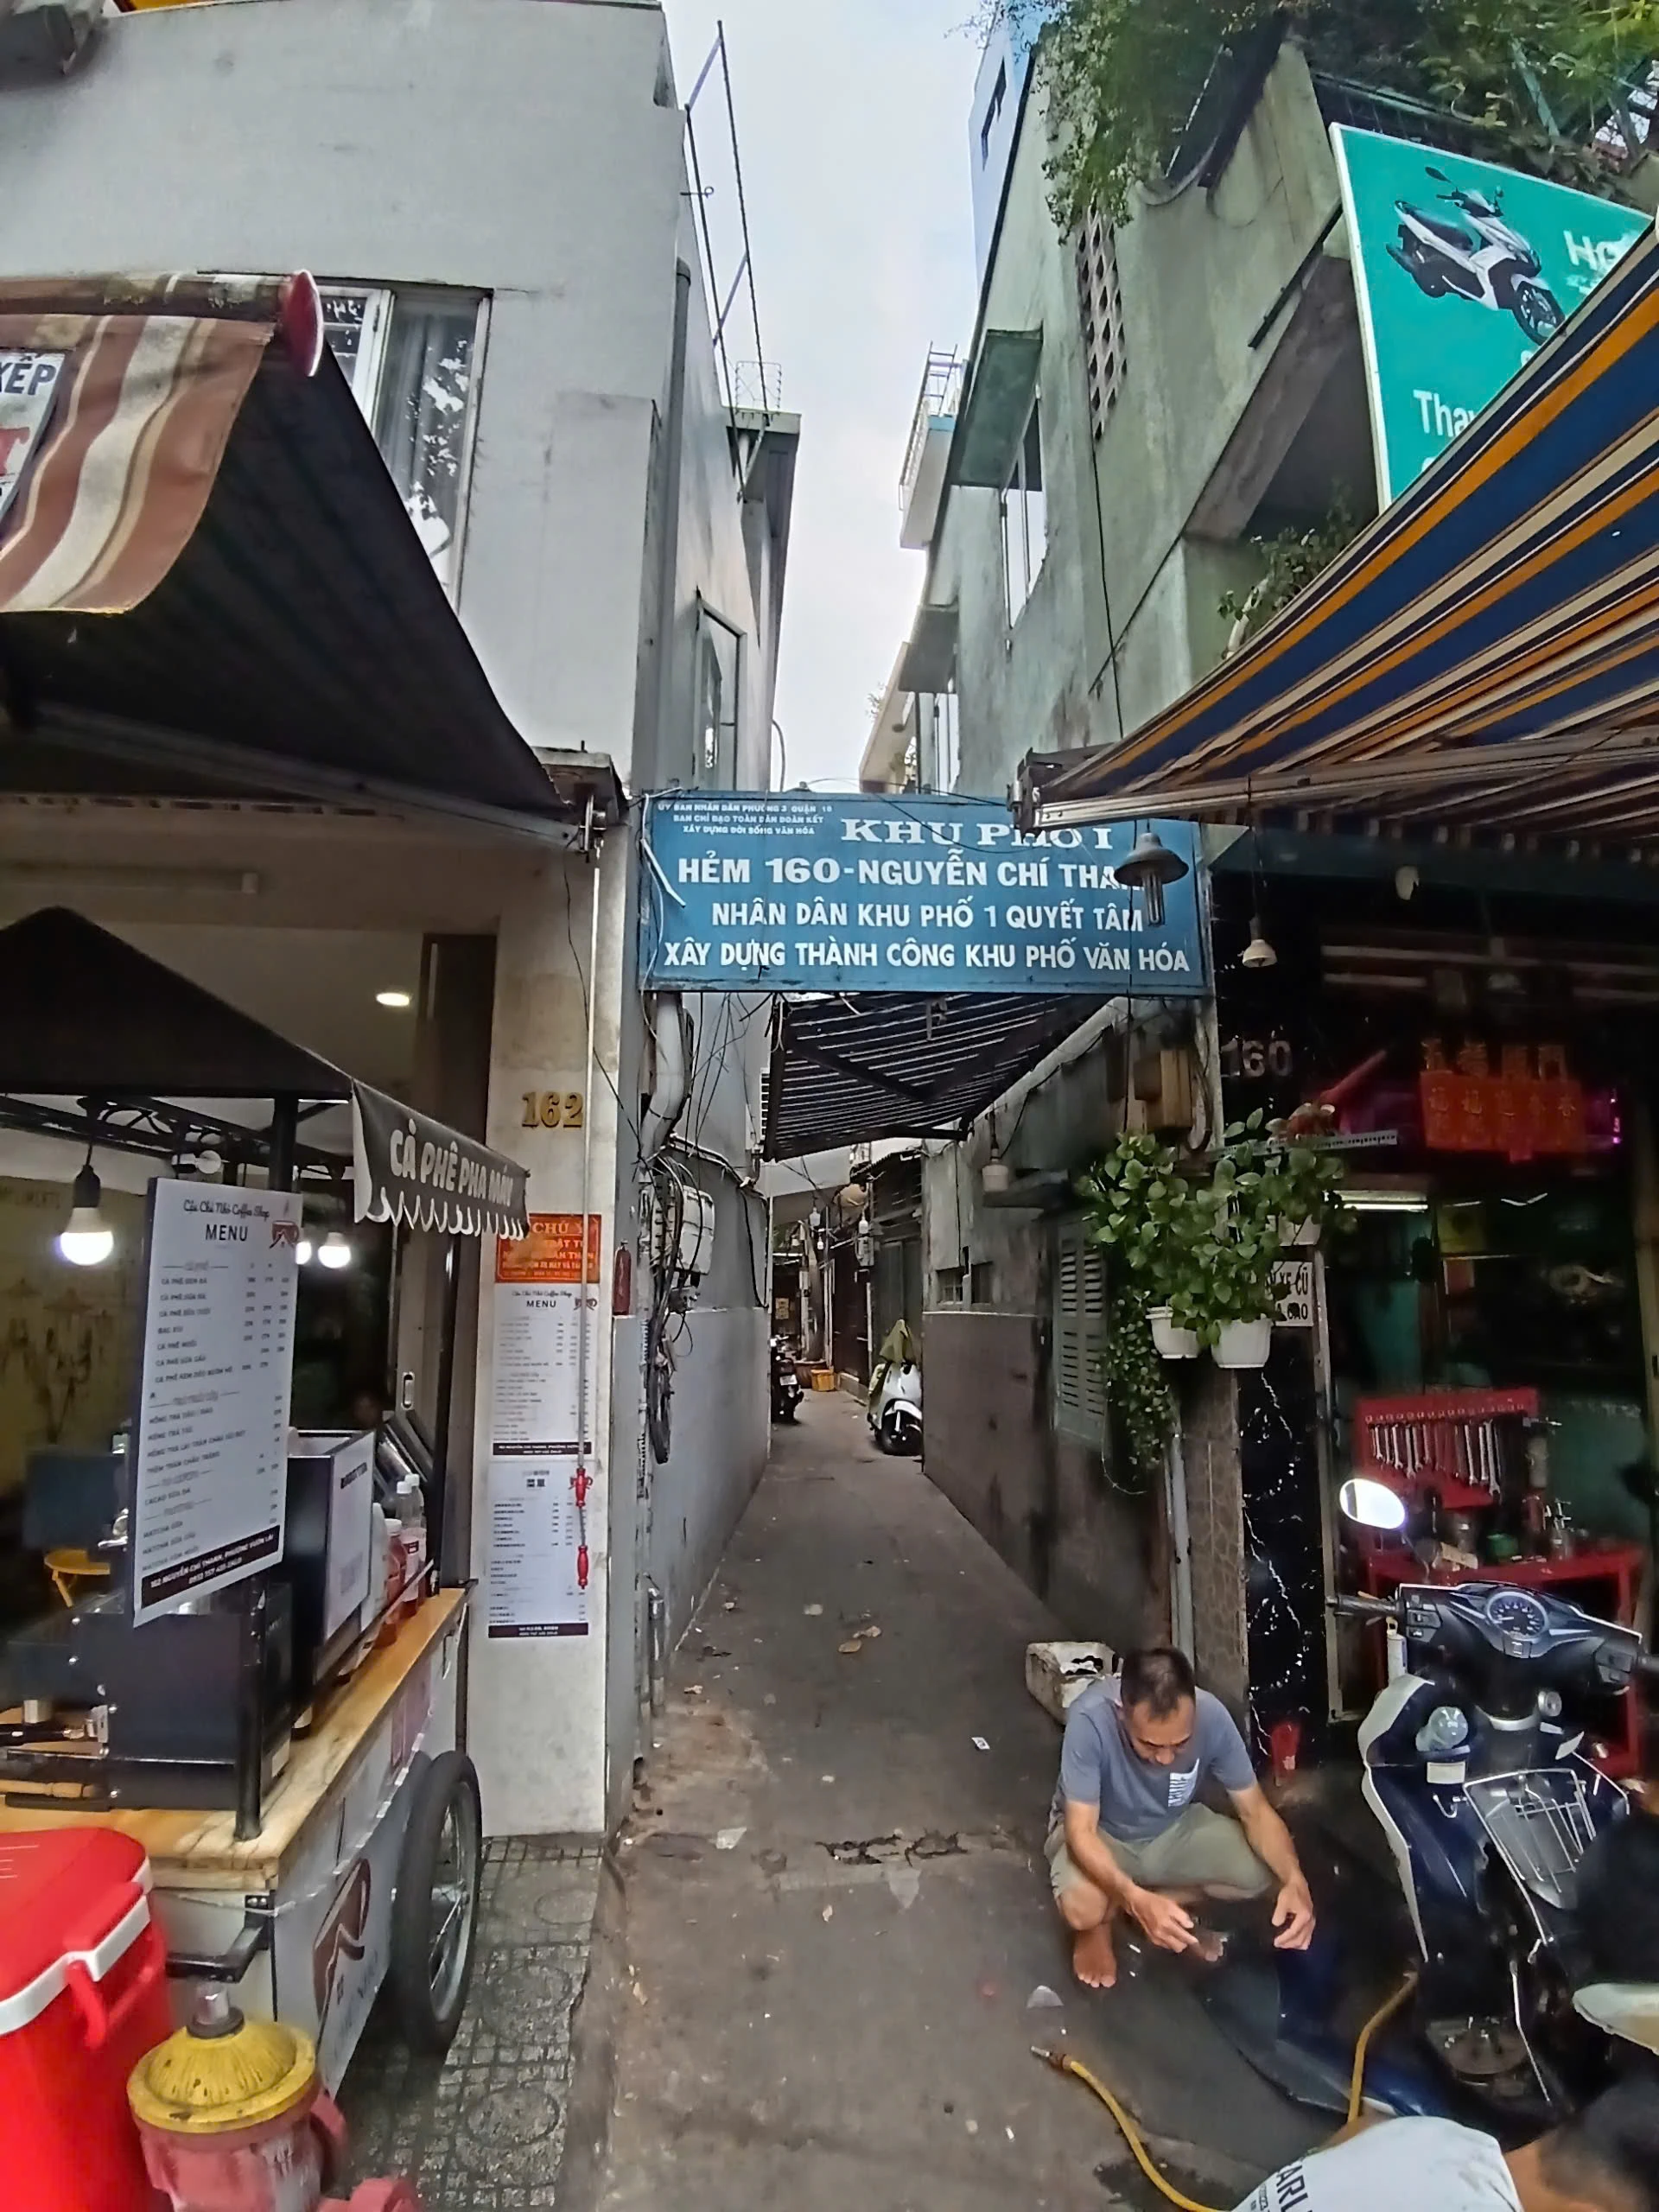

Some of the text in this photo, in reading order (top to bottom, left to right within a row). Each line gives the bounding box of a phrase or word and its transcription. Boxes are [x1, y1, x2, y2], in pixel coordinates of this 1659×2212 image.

[841, 818, 963, 845] KHU
[678, 850, 751, 883] HẺM
[997, 857, 1050, 887] CHÍ
[1058, 864, 1145, 891] THA
[712, 895, 1143, 932] NHÂN DÂN KHU PHỐ 1 QUYẾT TÂM
[664, 935, 1191, 972] XÂY DỰNG THÀNH CÔNG KHU PHỐ VĂN HÓA
[1220, 1038, 1293, 1077] 160
[521, 1091, 584, 1128] 162
[390, 1118, 416, 1180] CÀ
[420, 1140, 459, 1192] PHÊ
[458, 1156, 487, 1200] PHA
[205, 1224, 249, 1242] MENU
[526, 1300, 556, 1308] MENU
[1276, 2164, 1314, 2212] ARL
